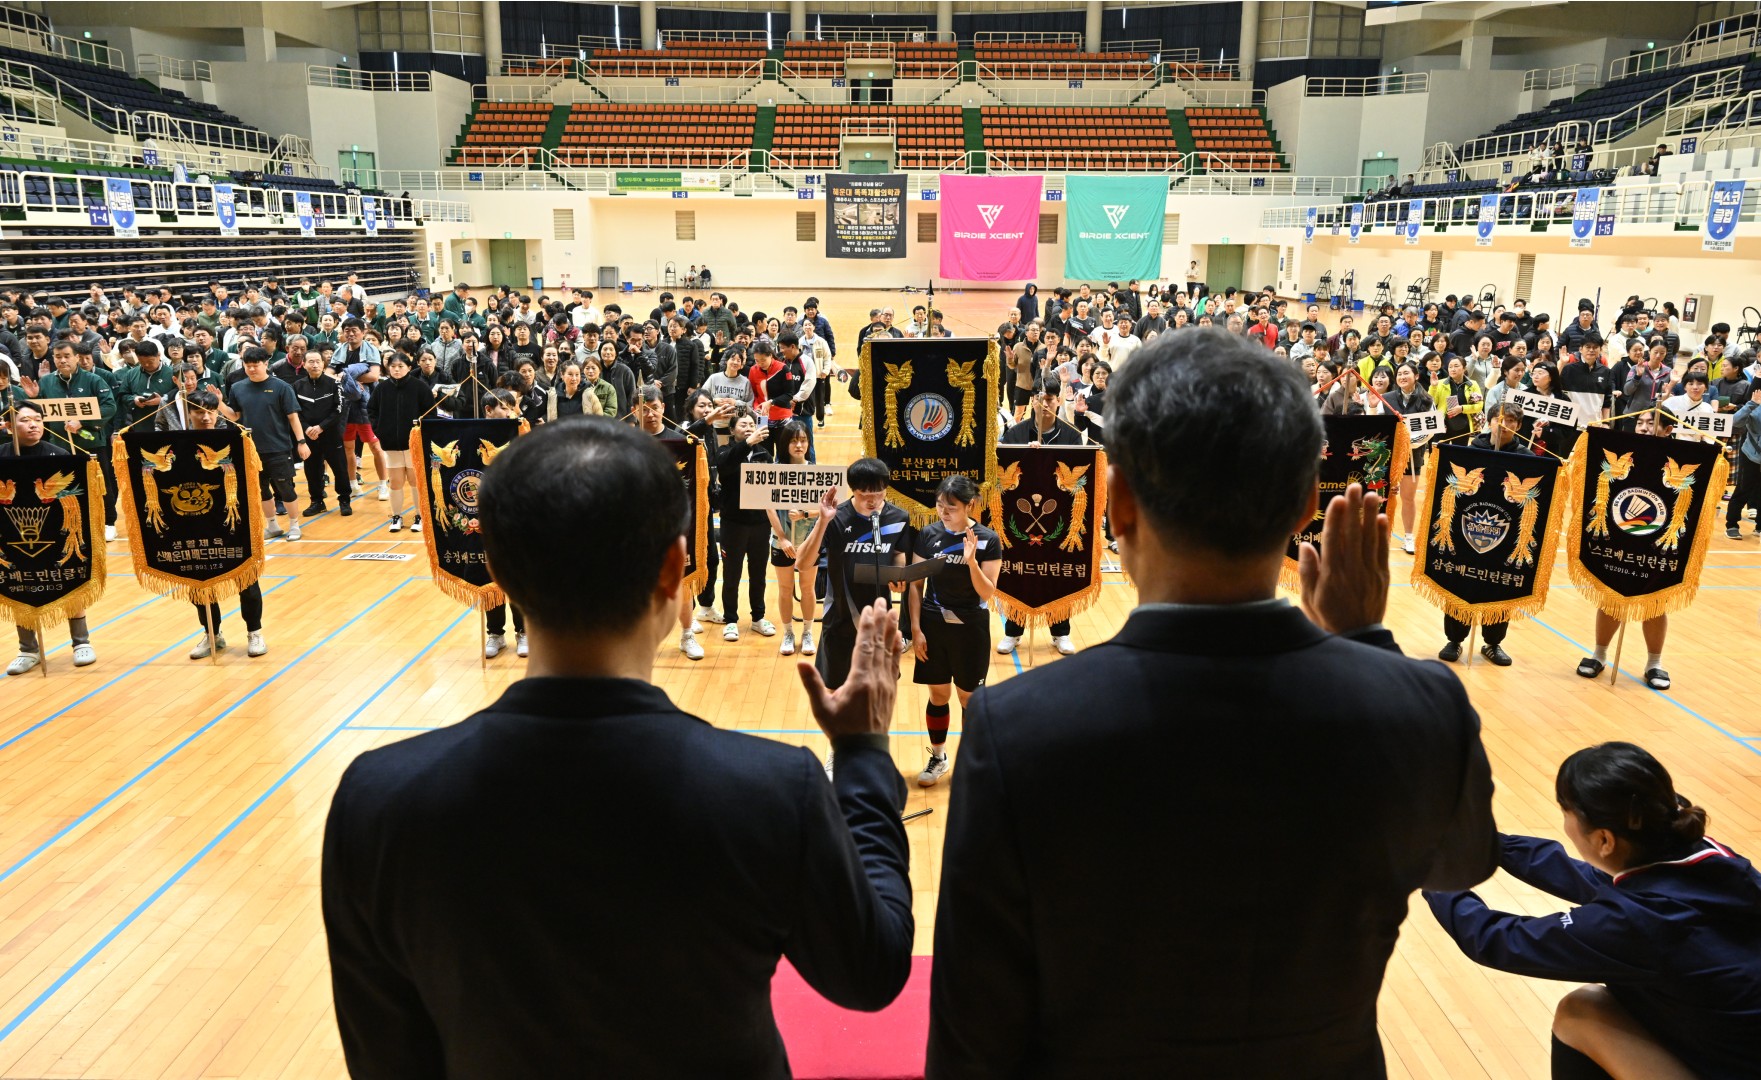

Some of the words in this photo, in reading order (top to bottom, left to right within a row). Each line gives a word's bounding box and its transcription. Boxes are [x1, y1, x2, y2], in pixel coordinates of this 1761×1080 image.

[832, 188, 852, 196] 해운대
[92, 212, 108, 224] 1-4
[1713, 208, 1734, 224] 클럽
[1598, 224, 1611, 234] 1-15
[1513, 395, 1573, 421] 벡스코클럽
[1409, 417, 1437, 432] 클럽
[902, 457, 958, 469] 부산광역시
[779, 471, 842, 487] 해운대구청장기
[1628, 490, 1658, 501] BADMINTON
[156, 546, 243, 562] 신해운대배드민턴클럽
[1588, 542, 1678, 572] 스코배드민턴클럽
[1432, 558, 1524, 587] 삼솔배드민턴클럽
